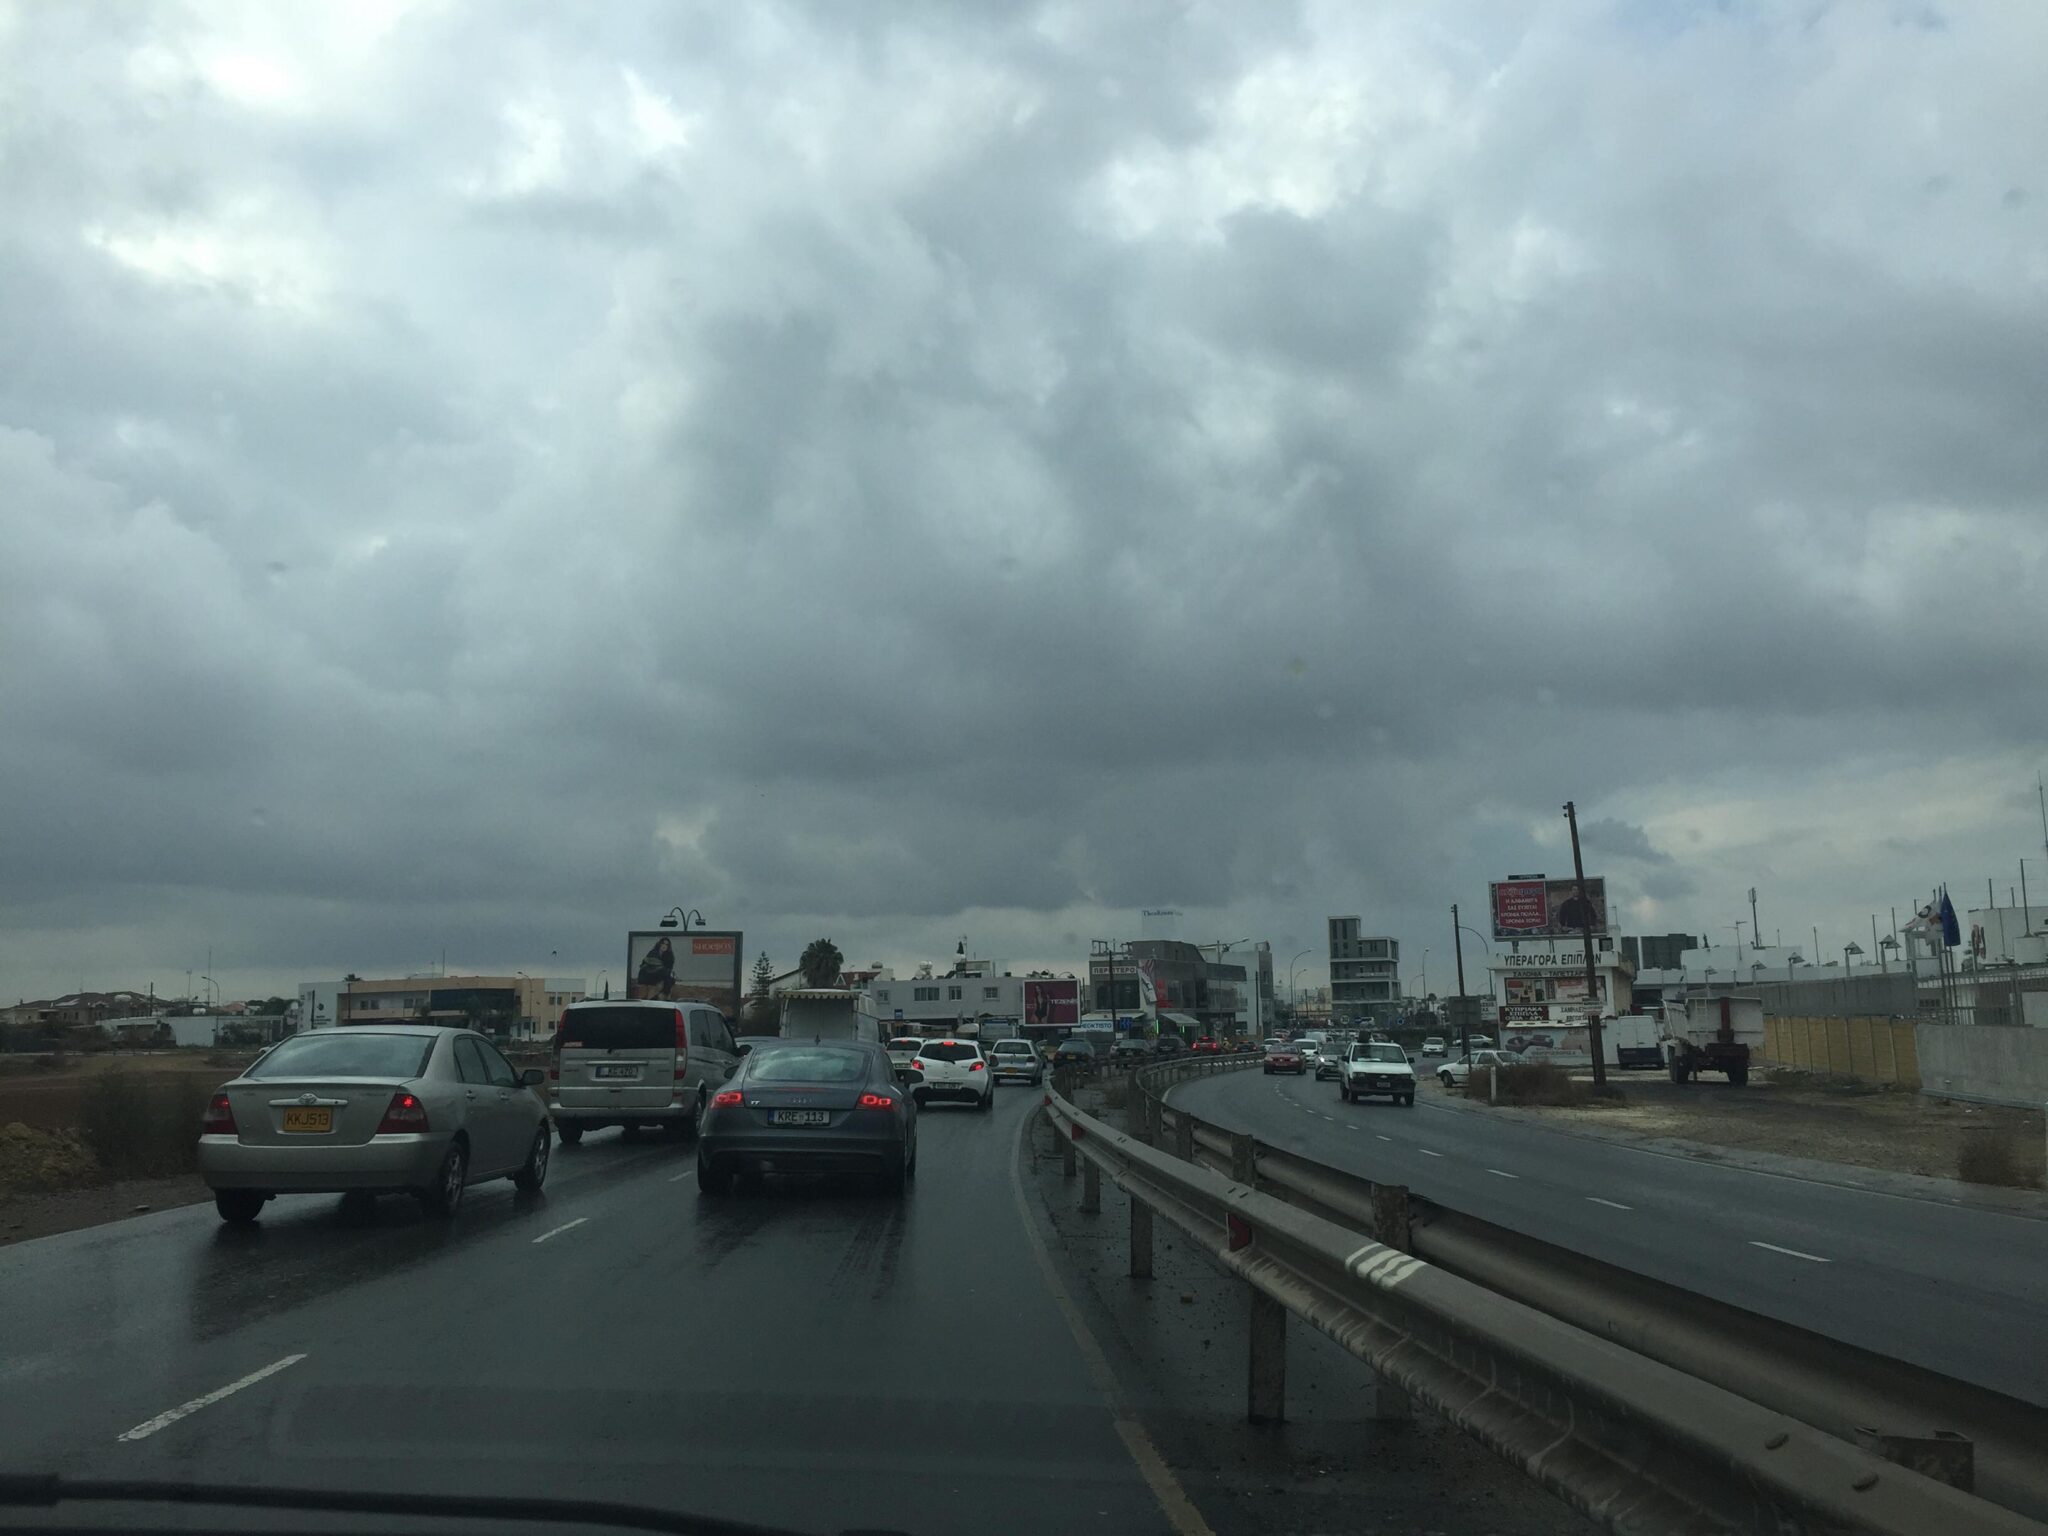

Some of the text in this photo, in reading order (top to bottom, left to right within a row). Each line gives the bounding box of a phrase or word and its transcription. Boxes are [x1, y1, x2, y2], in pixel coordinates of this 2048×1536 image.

[1504, 953, 1601, 966] ΥΠΕΡΑΓΟΡΑ ΕΠΙΠΛΝ
[286, 1112, 328, 1126] KKJ513
[778, 1111, 824, 1122] KRE 113
